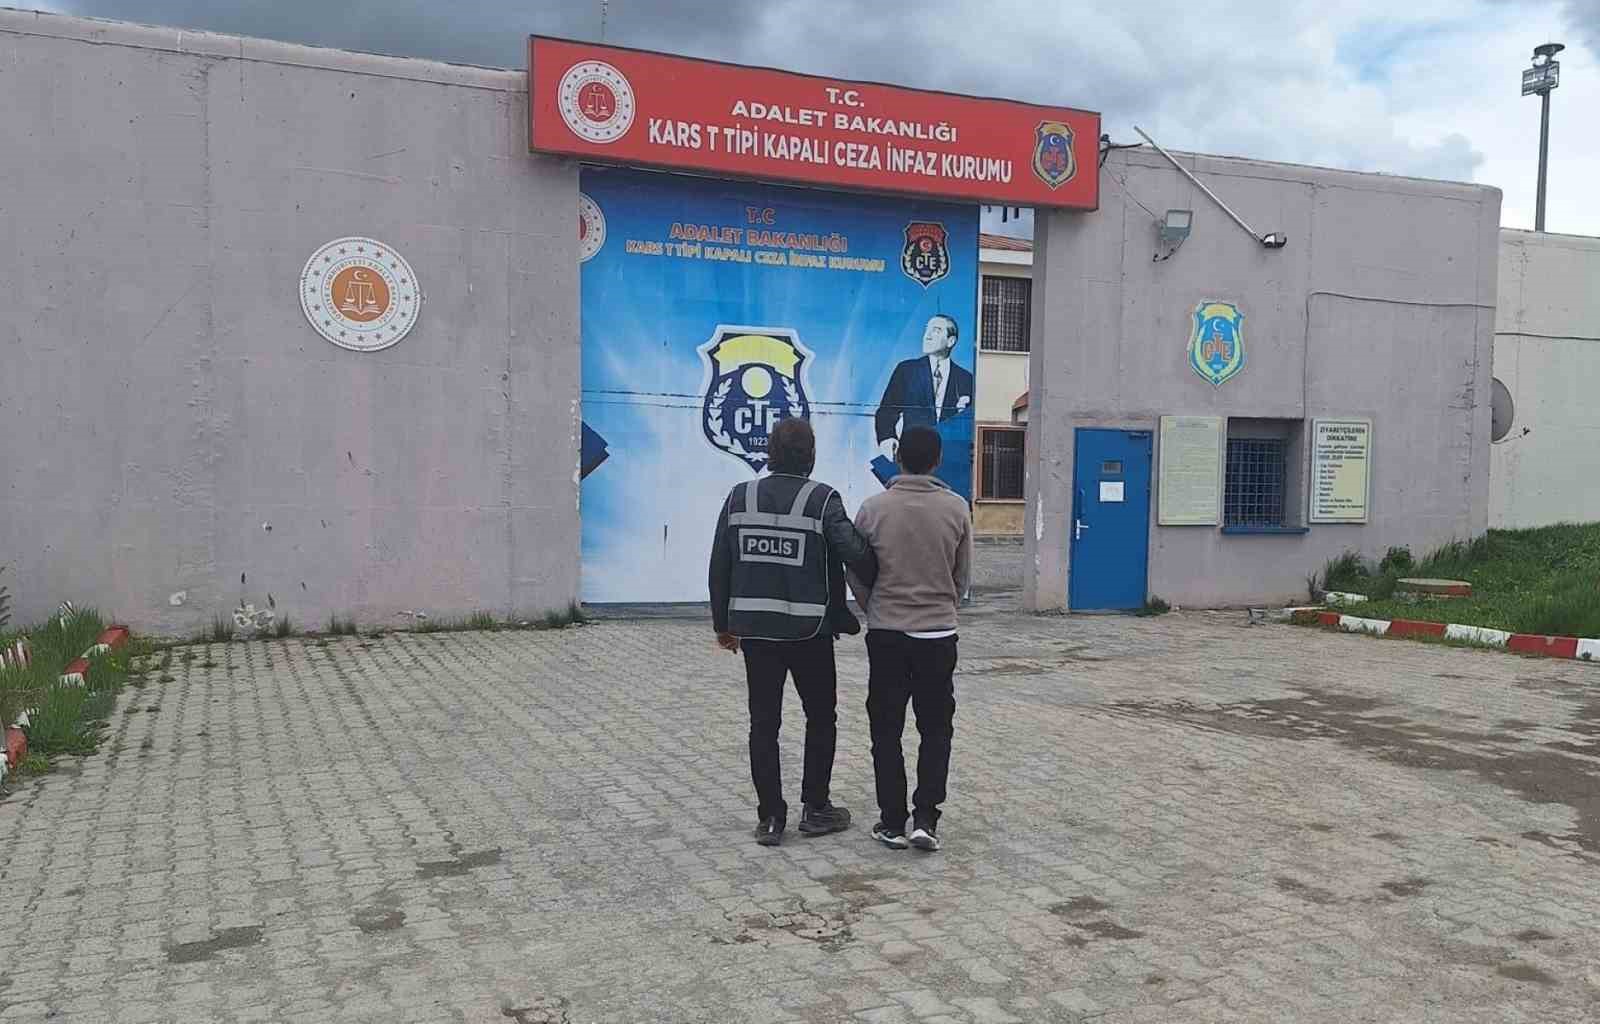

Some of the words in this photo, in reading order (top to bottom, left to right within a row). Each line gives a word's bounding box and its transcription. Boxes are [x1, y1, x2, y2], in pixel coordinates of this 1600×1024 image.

[825, 87, 865, 108] T.C.
[731, 100, 827, 127] ADALET
[834, 113, 957, 142] BAKANLIĞI
[648, 118, 701, 149] KARS
[706, 126, 719, 151] T
[723, 123, 758, 156] TİPİ
[764, 133, 829, 164] KAPALI
[834, 141, 882, 171] CEZA
[886, 141, 938, 176] İNFAZ
[942, 153, 1012, 183] KURUMU
[670, 222, 743, 244] ADALET
[746, 229, 848, 253] BAKANLIĞI
[625, 239, 663, 256] KARS
[665, 243, 674, 257] T
[674, 240, 702, 258] TİPİ
[704, 245, 752, 263] KAPALI
[754, 250, 787, 265] CEZA
[916, 253, 937, 270] CTE
